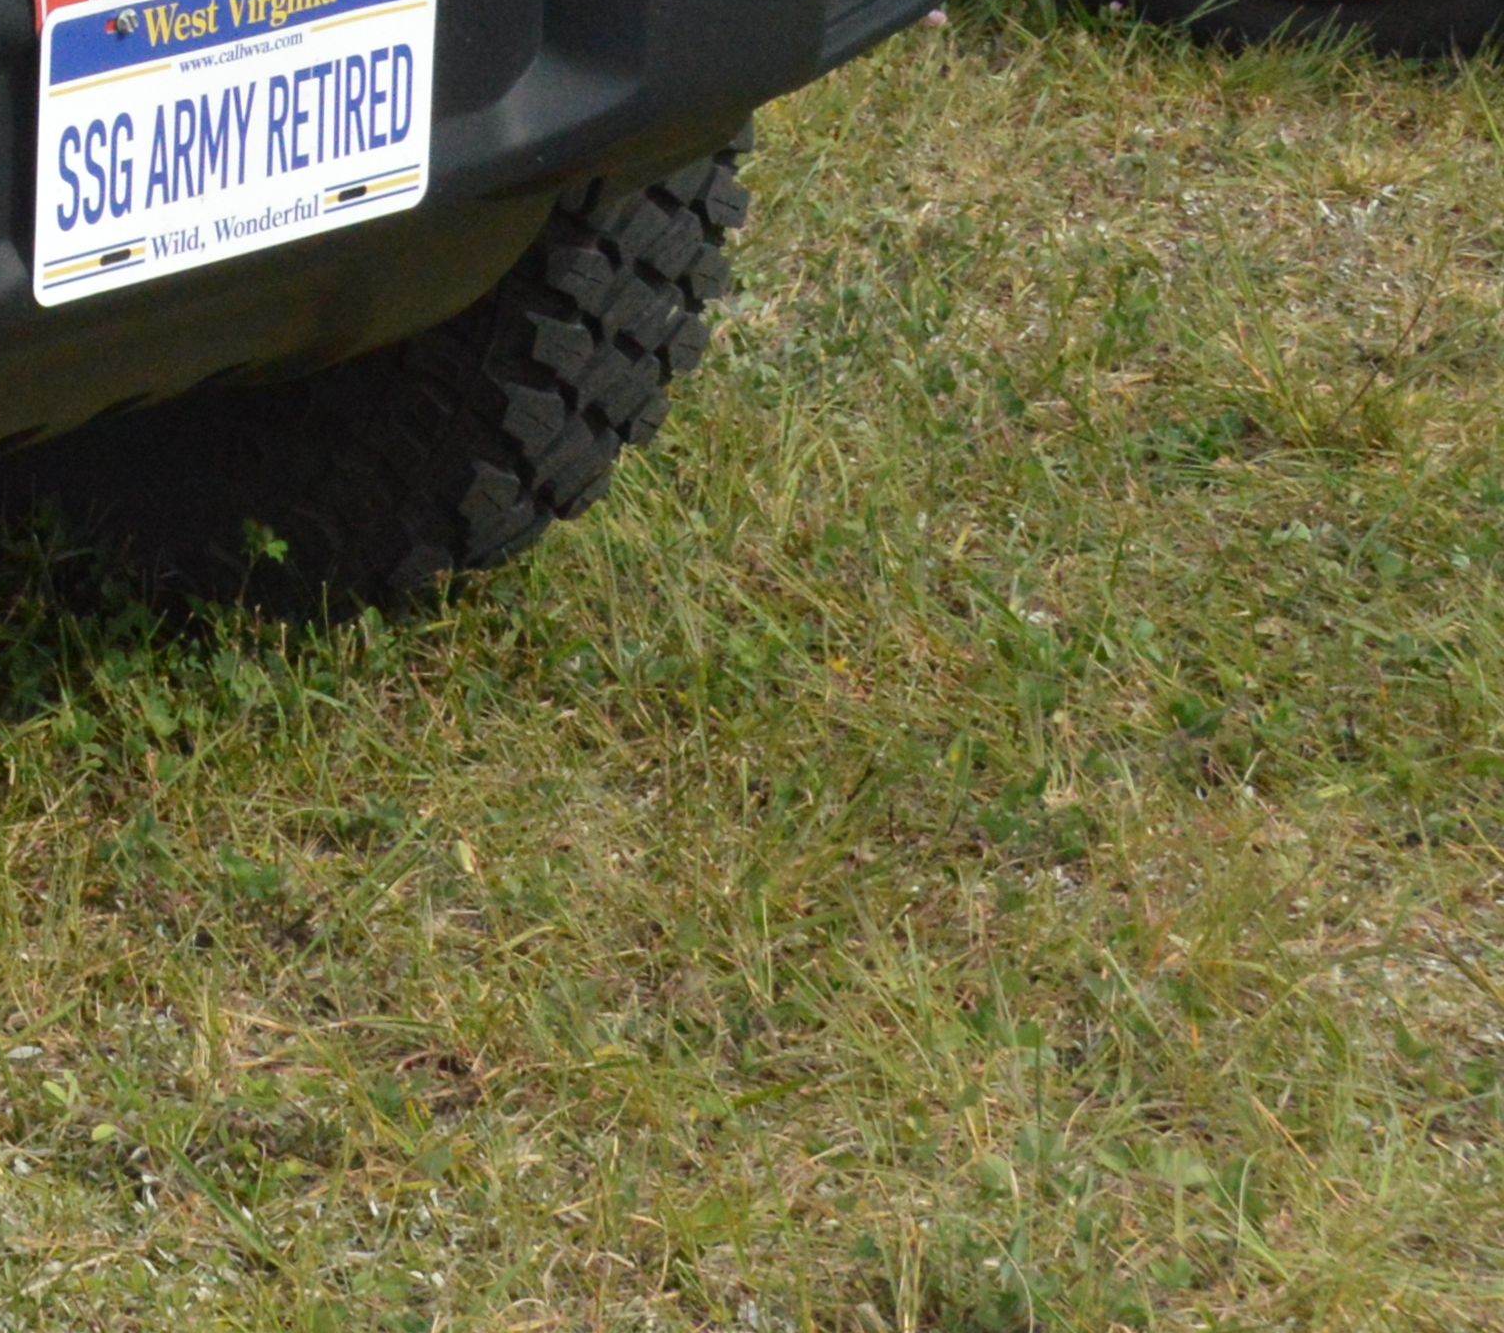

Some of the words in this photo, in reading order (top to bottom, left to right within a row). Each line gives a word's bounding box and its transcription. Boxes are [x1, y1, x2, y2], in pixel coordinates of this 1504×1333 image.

[179, 32, 303, 73] www.callwva.com
[57, 112, 134, 232] SSG
[145, 81, 257, 210] ARMY
[266, 43, 414, 177] RETIRED
[151, 223, 206, 261] Wild,
[214, 194, 320, 240] Wonderful
